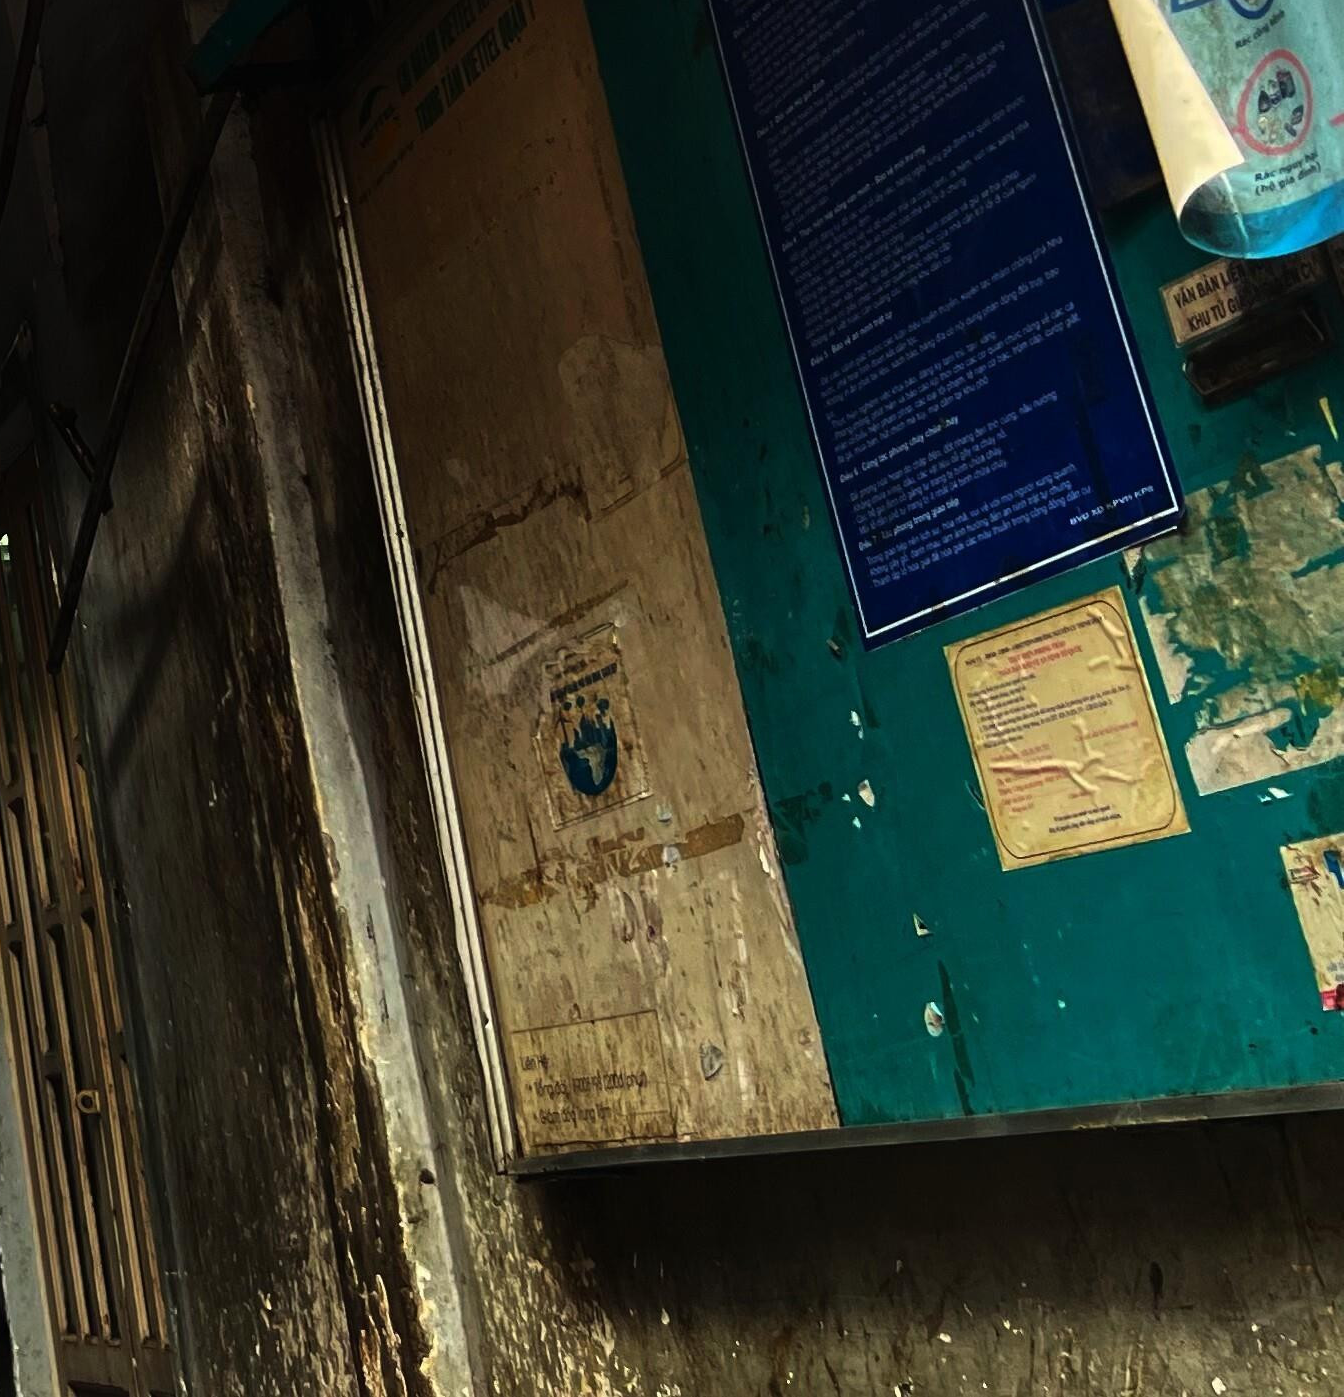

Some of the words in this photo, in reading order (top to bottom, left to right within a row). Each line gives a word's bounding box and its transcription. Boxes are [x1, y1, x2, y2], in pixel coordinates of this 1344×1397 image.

[1254, 168, 1276, 183] Rác
[1173, 286, 1197, 309] VĂN
[1196, 273, 1220, 298] BẢN
[1187, 310, 1212, 333] KHU
